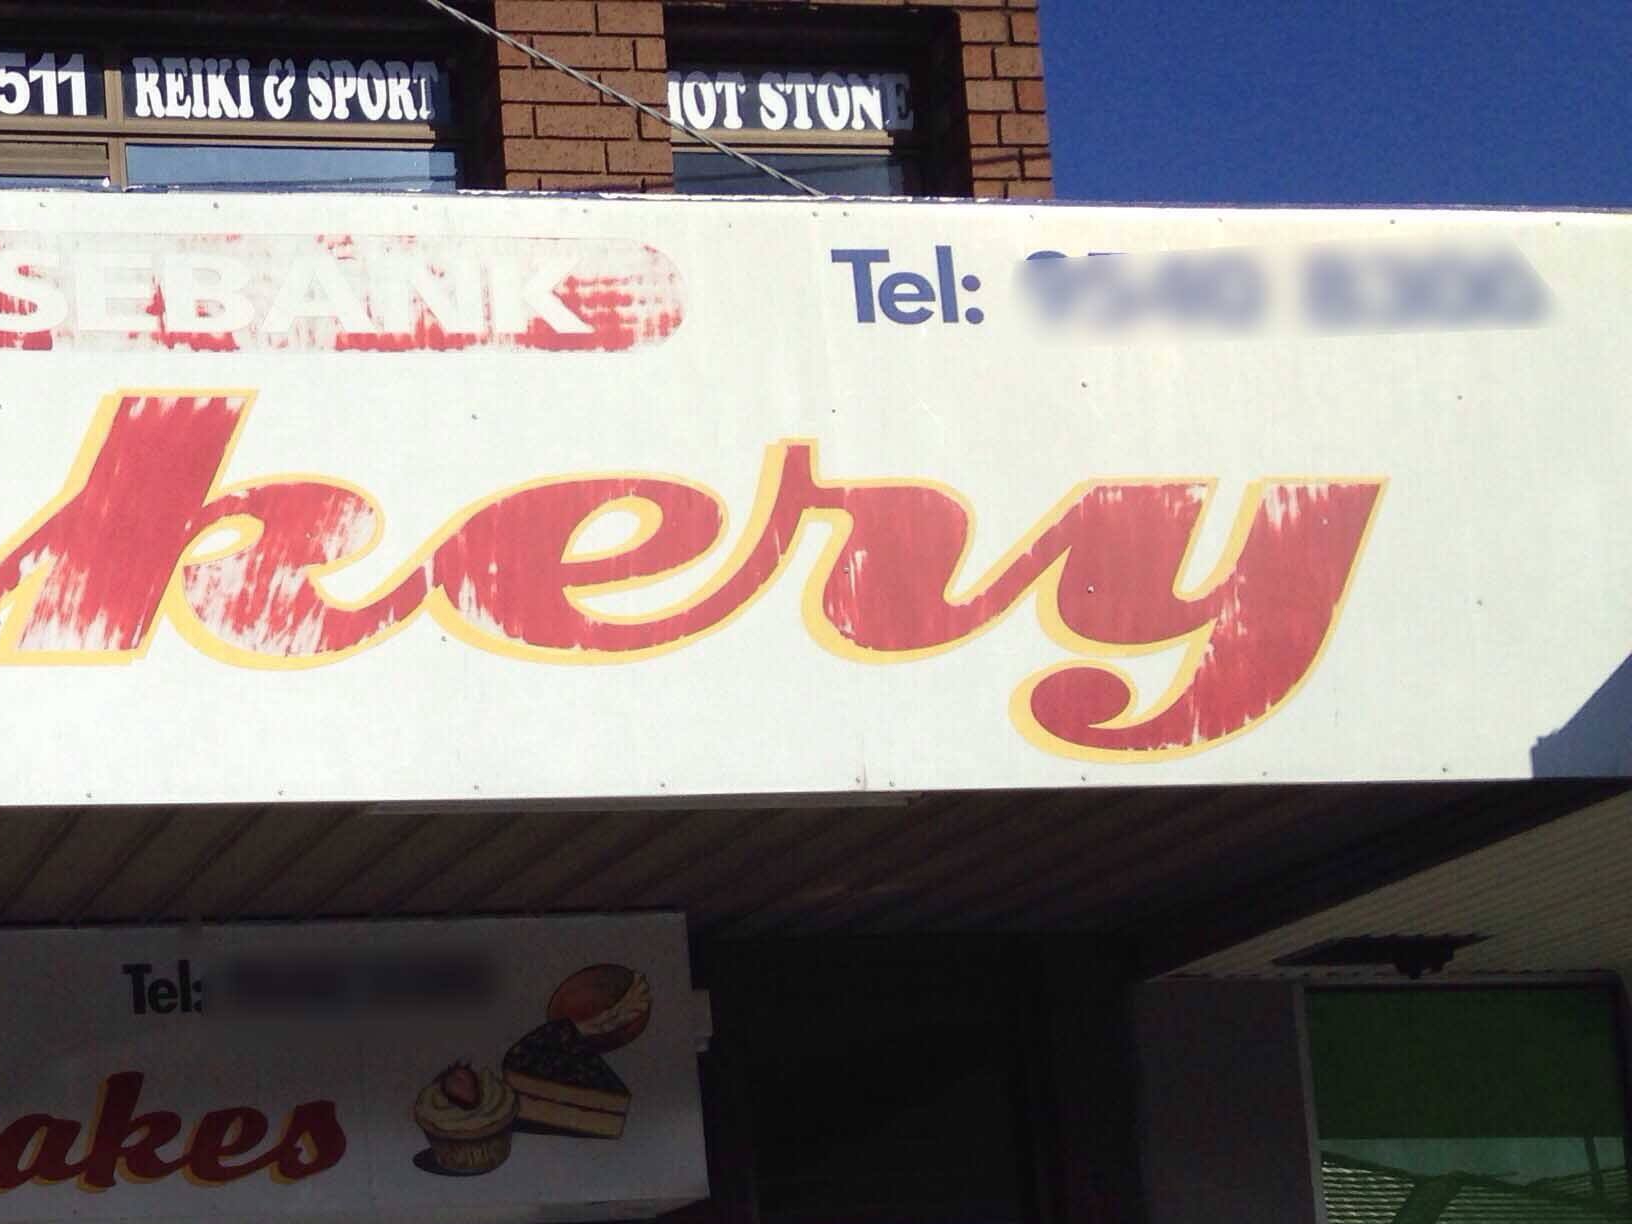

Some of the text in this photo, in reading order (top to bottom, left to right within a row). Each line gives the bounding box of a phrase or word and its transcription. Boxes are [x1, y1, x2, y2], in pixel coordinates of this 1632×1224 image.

[133, 55, 439, 123] REIKI & SPORT
[758, 71, 914, 131] STONE
[830, 244, 985, 326] Tel:
[121, 960, 205, 1017] Tel:
